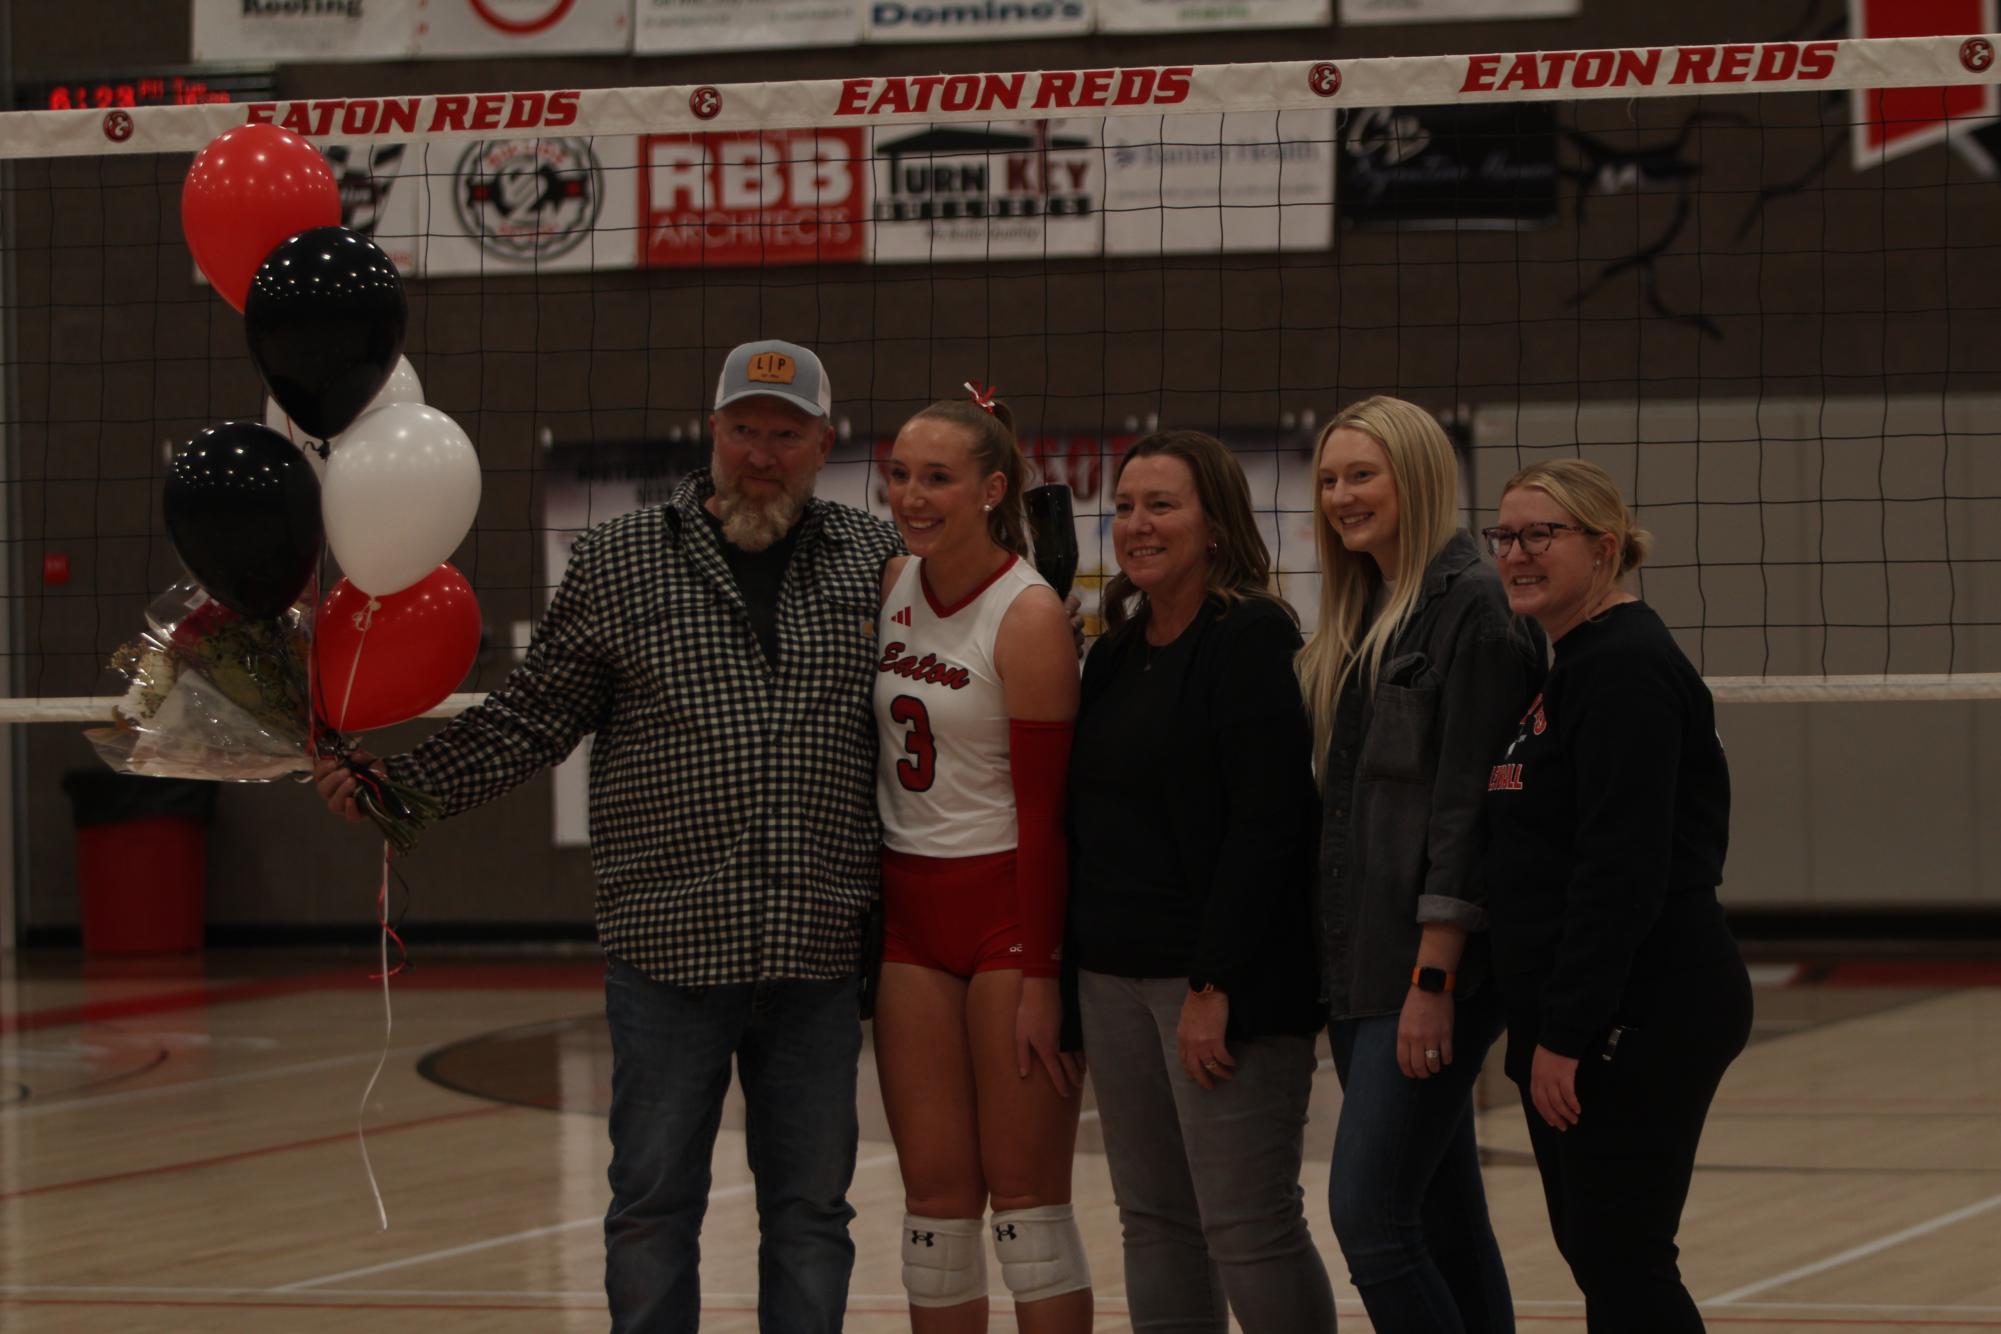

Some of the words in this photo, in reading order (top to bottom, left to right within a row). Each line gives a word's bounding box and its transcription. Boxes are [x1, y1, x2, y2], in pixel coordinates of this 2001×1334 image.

[873, 2, 1082, 27] Domino's
[834, 73, 1026, 115] EATON
[1031, 67, 1194, 109] REDS
[1459, 49, 1662, 92] EATON
[1668, 42, 1839, 85] REDS
[247, 98, 421, 136] EATON
[427, 91, 580, 132] REDS
[652, 136, 855, 212] RBB
[652, 207, 853, 249] ARCHITECTS
[878, 641, 970, 690] Eaton
[890, 694, 937, 793] 3
